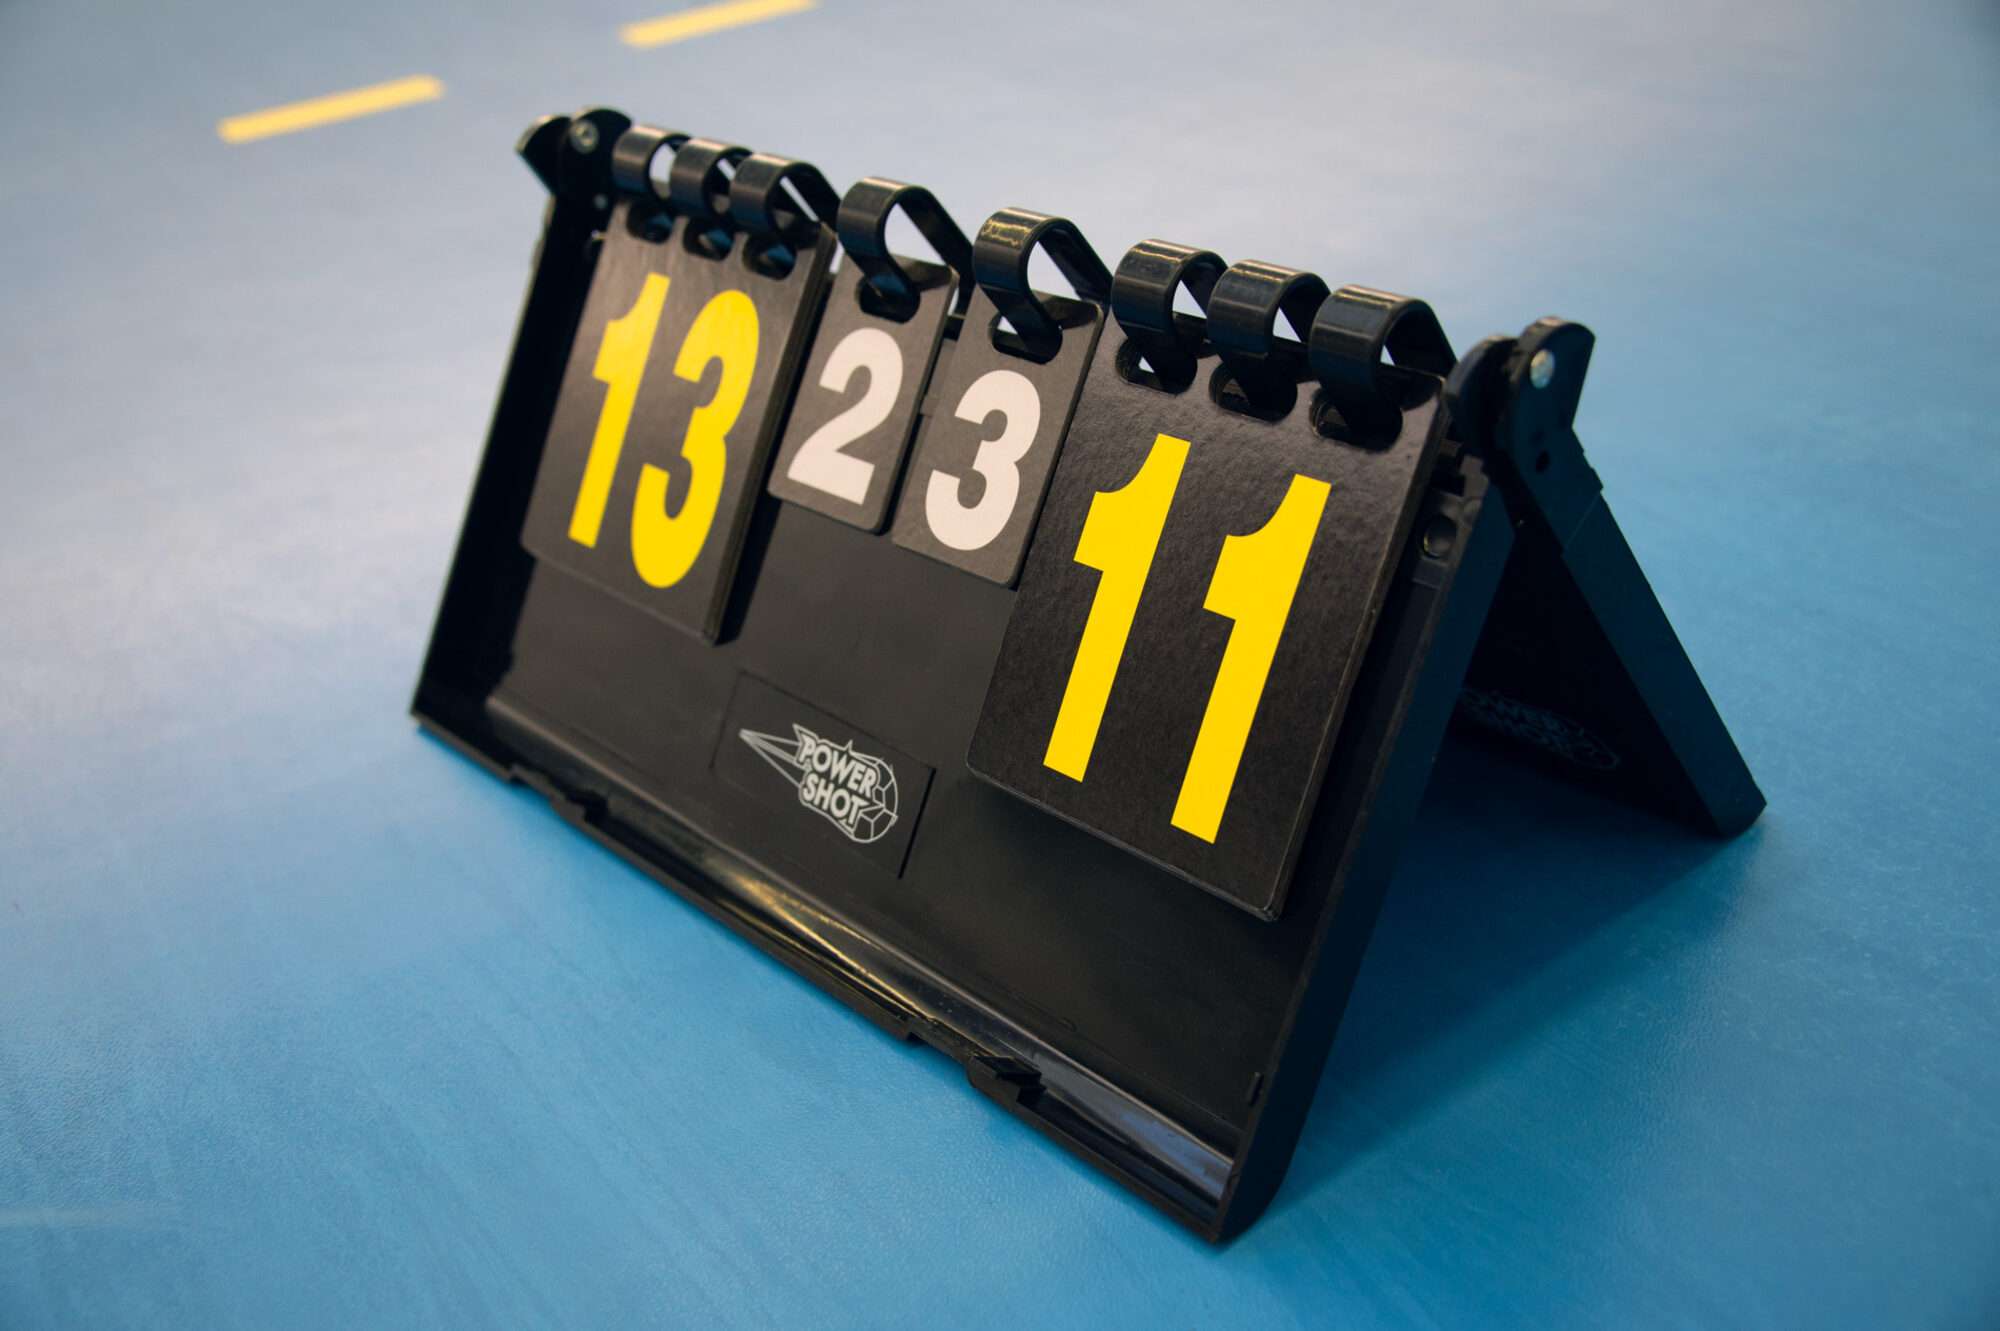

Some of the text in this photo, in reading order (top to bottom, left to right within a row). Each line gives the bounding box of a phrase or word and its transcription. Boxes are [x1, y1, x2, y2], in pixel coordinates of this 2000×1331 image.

[569, 271, 761, 588] 13
[787, 327, 903, 505] 2
[925, 370, 1040, 550] 3
[1044, 433, 1331, 843] 11
[798, 734, 877, 799] POWER
[803, 774, 869, 825] SHOT
